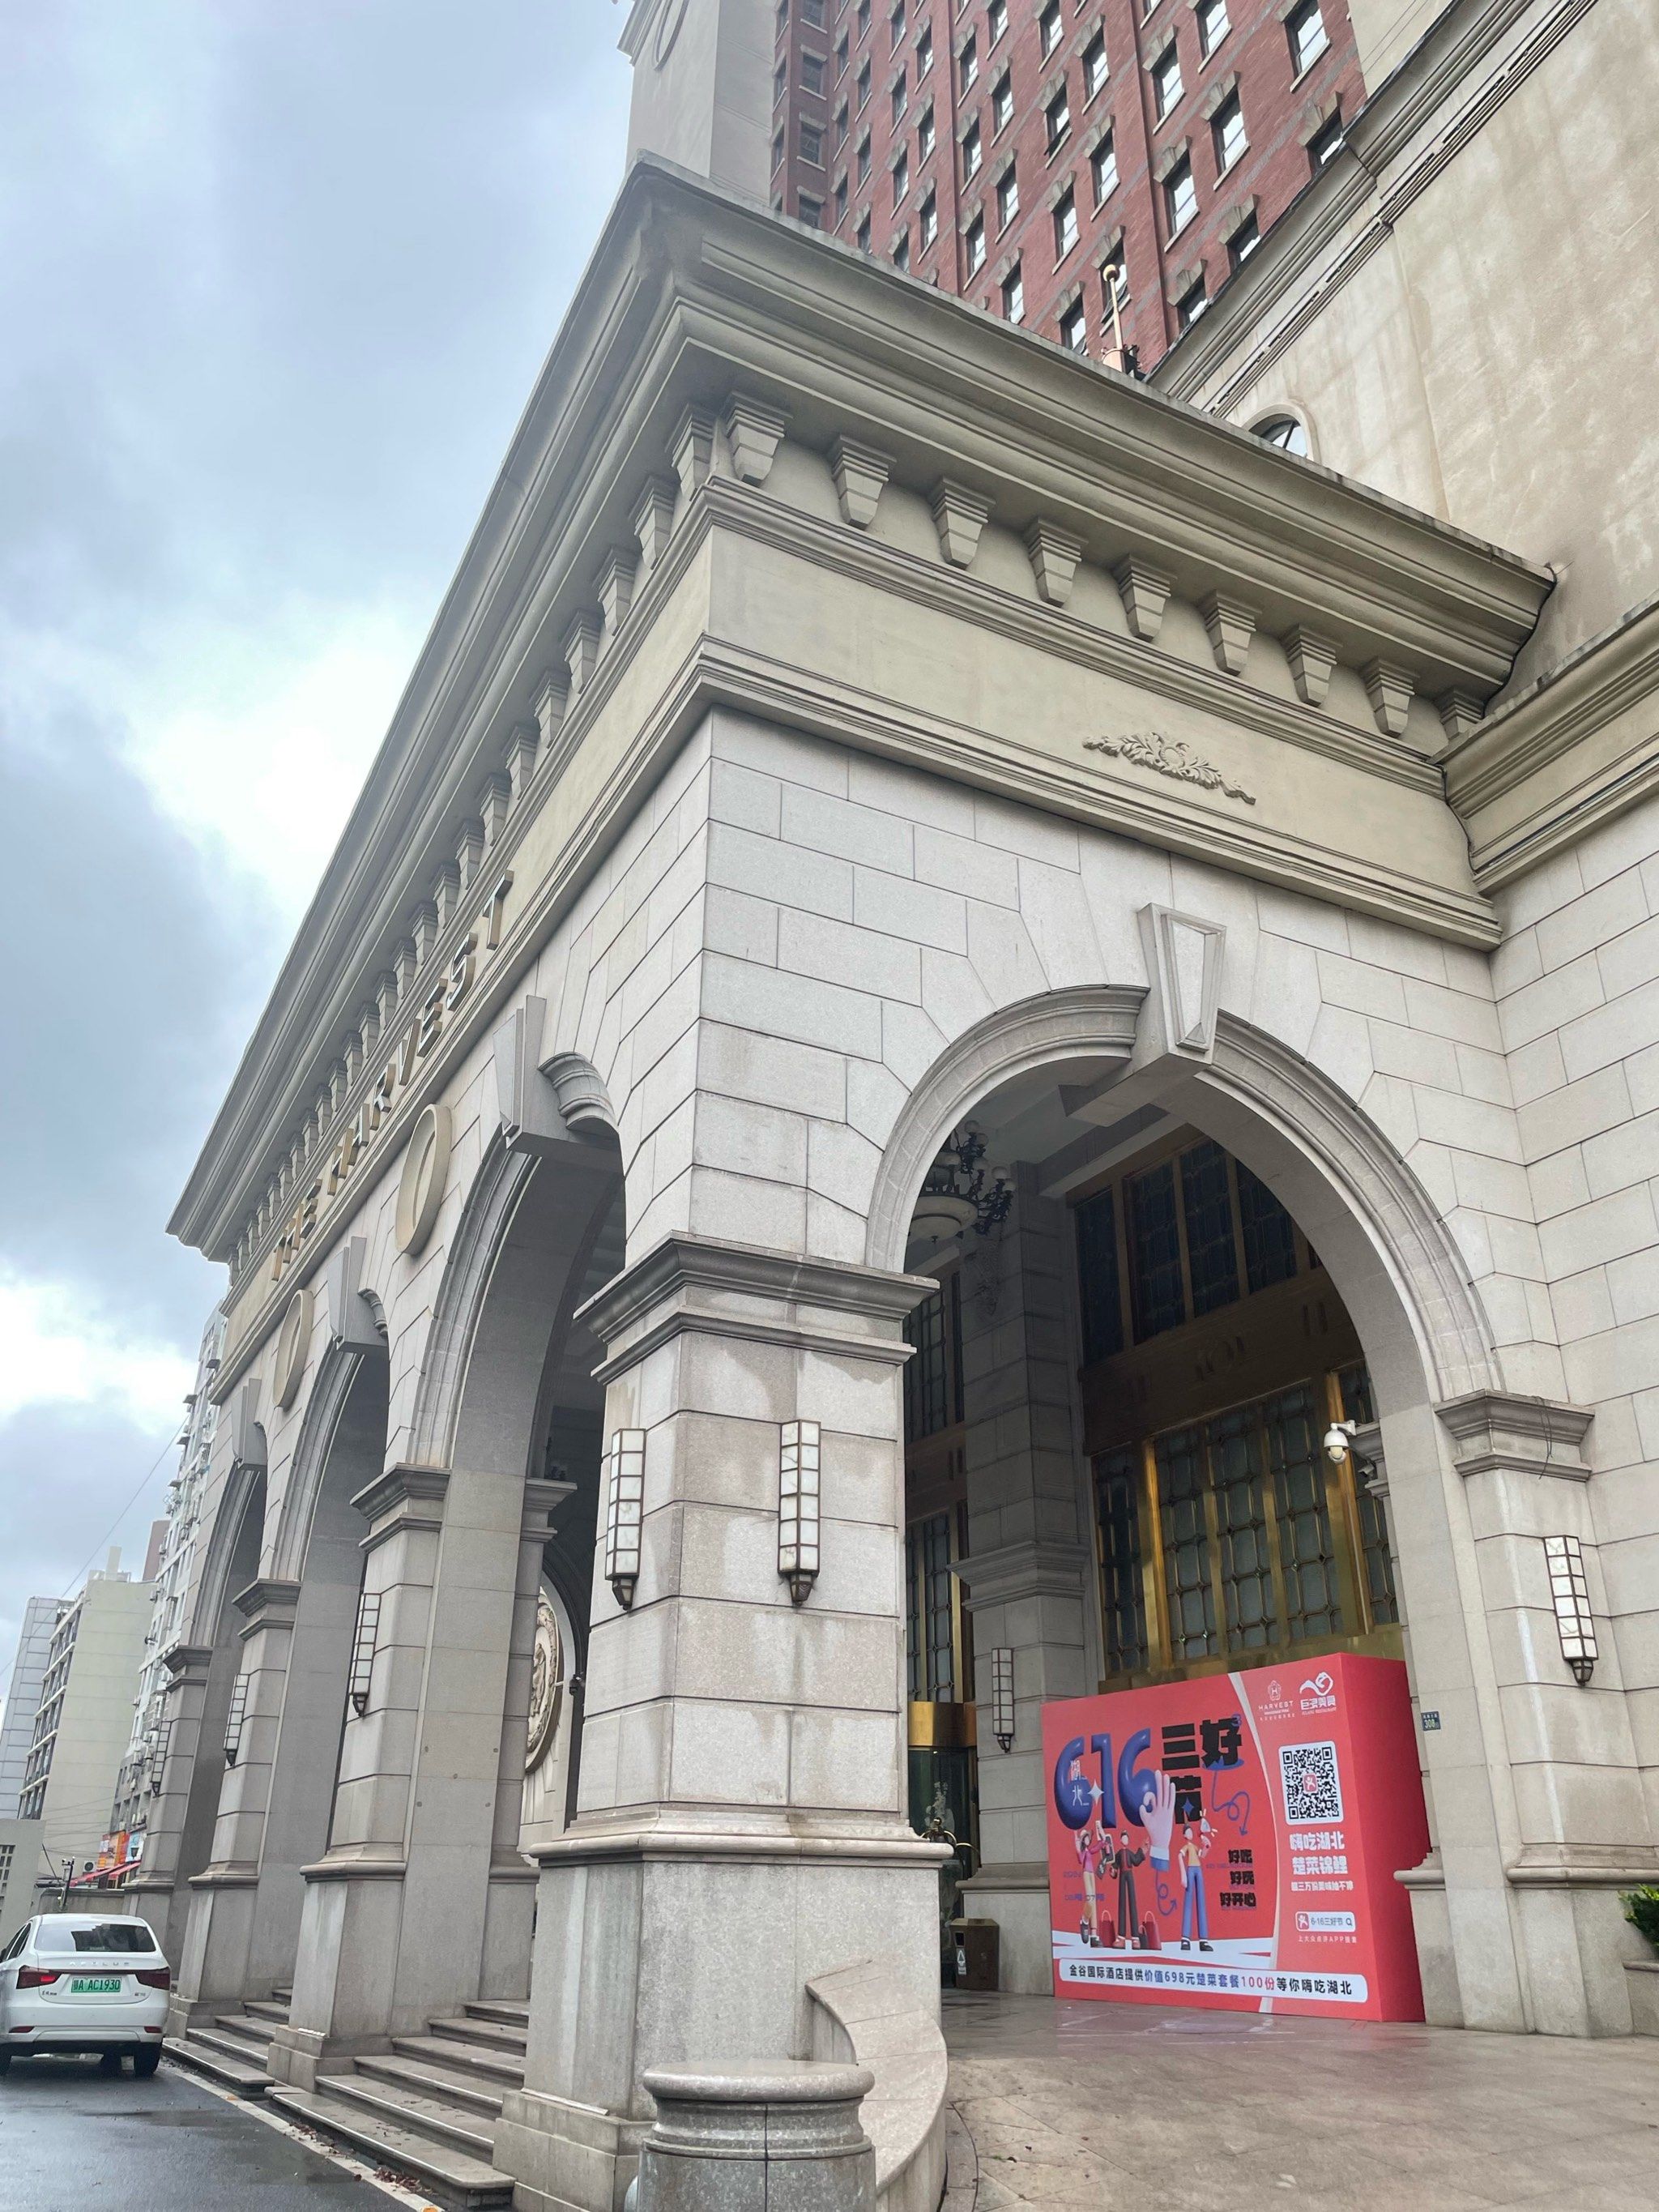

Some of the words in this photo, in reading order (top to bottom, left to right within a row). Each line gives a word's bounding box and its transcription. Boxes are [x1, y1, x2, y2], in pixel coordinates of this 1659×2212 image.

[271, 1178, 322, 1282] THE
[327, 869, 514, 1196] HARVEST
[1258, 1701, 1294, 1710] HARVEST
[1054, 1728, 1158, 1830] 616
[1290, 1831, 1345, 1851] 嗨吃湖北
[1228, 1849, 1252, 1864] 好吃
[1292, 1855, 1348, 1875] 楚菜锦鲤
[1230, 1871, 1255, 1885] 好玩
[1220, 1892, 1256, 1907] 好开心
[1069, 1964, 1352, 1996] 金谷国际酒店提供价值698元楚菜套餐100份等你嗨吃湖北
